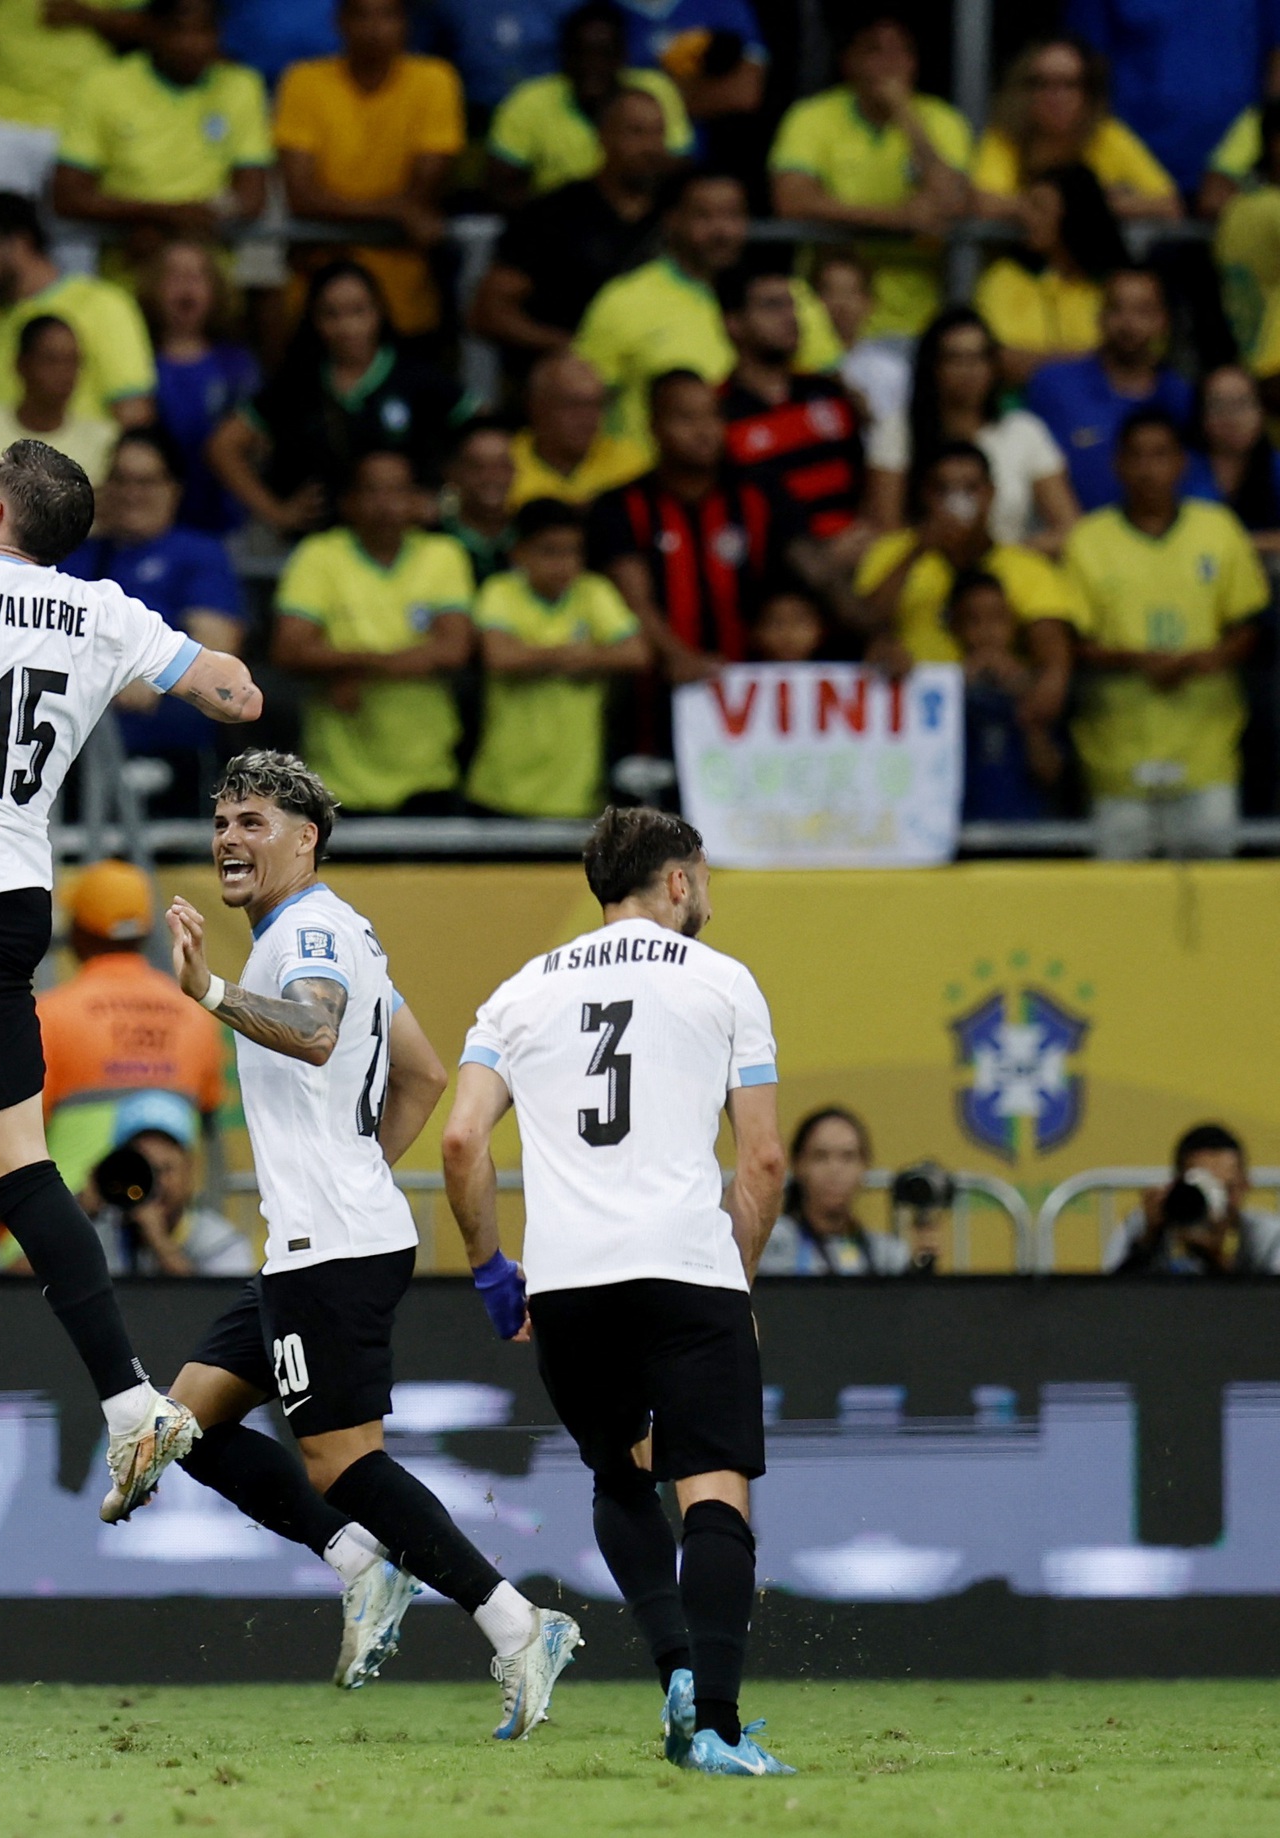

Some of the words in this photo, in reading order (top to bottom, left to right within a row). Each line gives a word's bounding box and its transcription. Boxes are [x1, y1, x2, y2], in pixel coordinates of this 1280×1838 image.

[709, 677, 904, 737] VINI
[543, 937, 688, 974] M.SARACCHI
[577, 1000, 634, 1147] 3
[273, 1332, 310, 1397] 20
